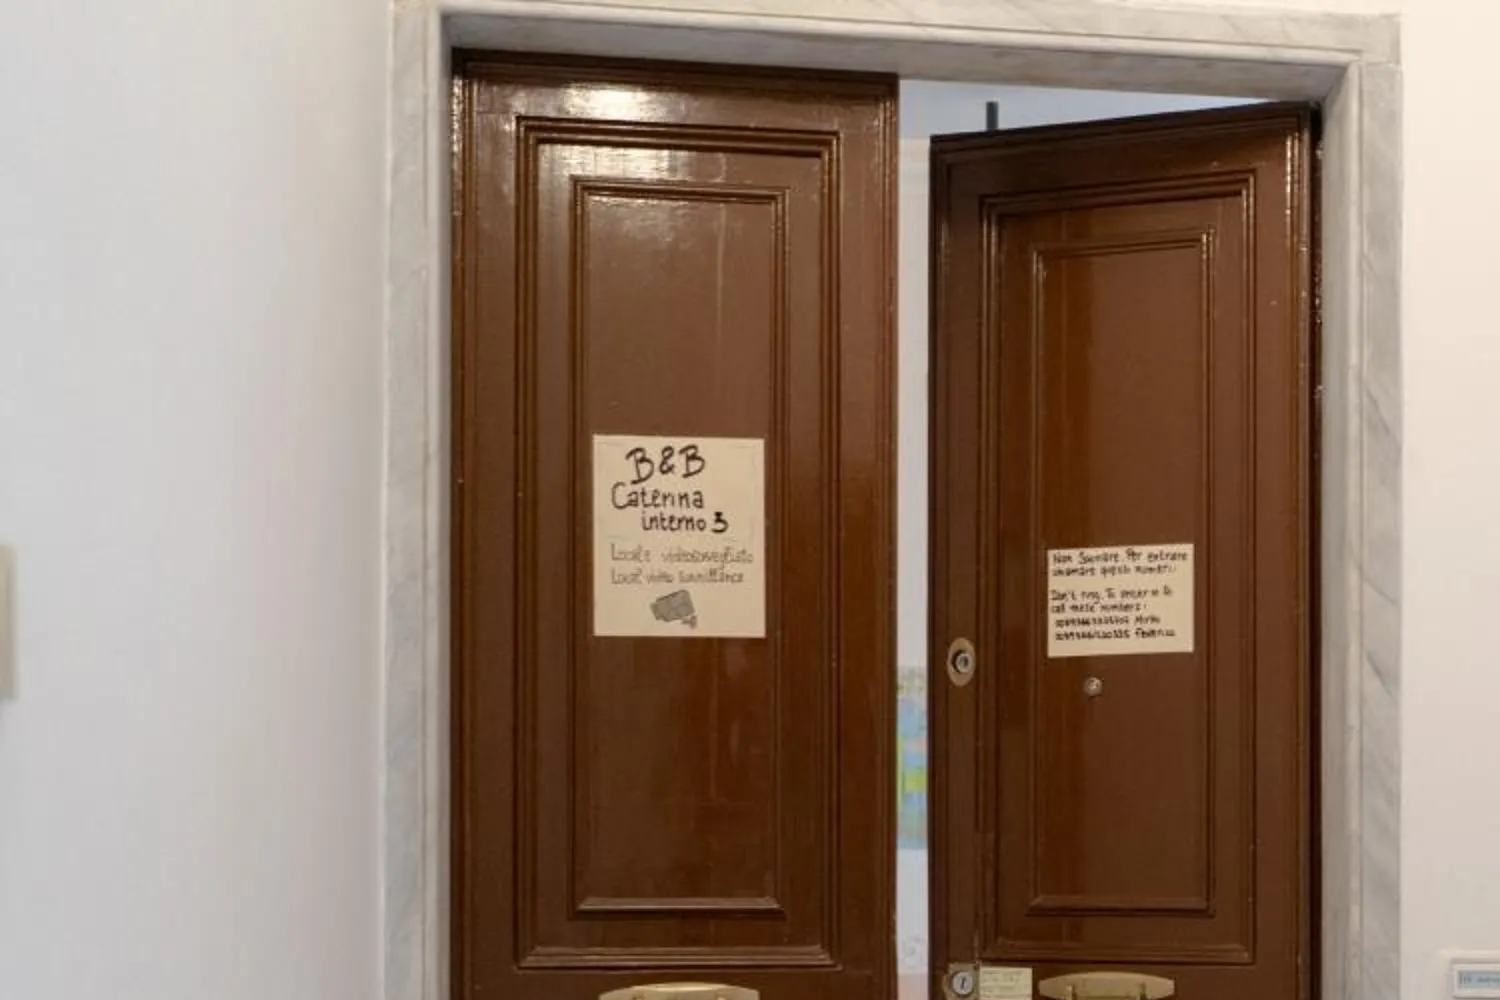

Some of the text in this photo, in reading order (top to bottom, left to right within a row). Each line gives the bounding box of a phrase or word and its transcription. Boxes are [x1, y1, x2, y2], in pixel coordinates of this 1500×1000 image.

[625, 444, 706, 484] B&B
[641, 511, 729, 534] interno 3
